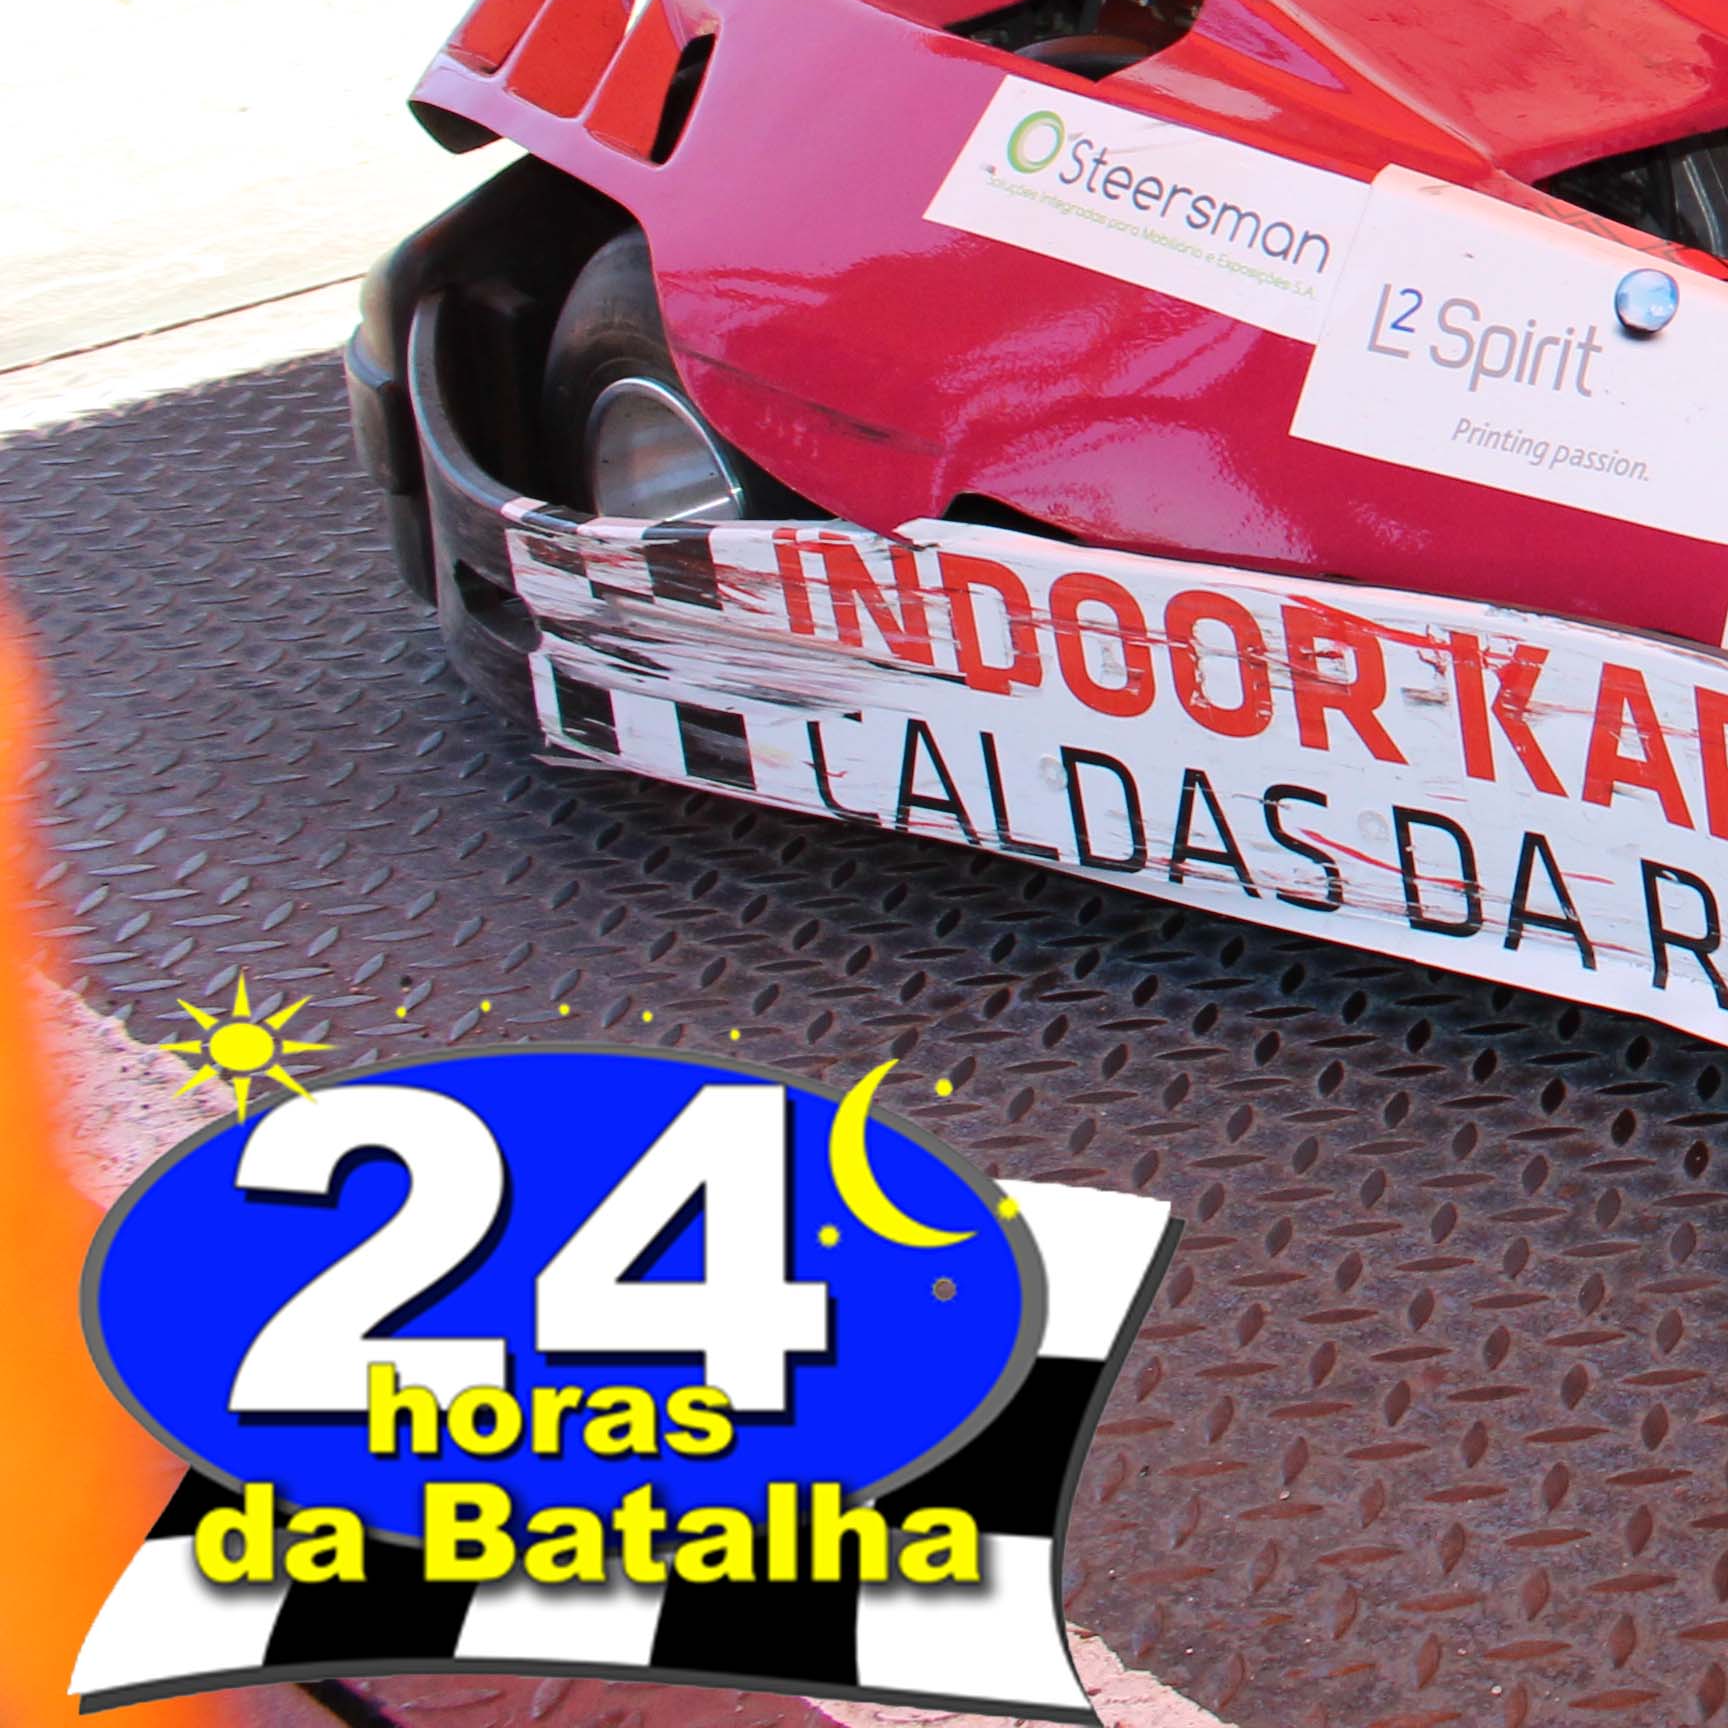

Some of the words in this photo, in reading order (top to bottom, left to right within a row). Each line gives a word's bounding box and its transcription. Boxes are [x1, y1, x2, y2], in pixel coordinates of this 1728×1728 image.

[1059, 138, 1331, 274] Steersman
[1428, 296, 1603, 398] Spirit
[1451, 417, 1550, 467] Printing
[1549, 443, 1650, 483] passion.
[773, 528, 1408, 764] INDOOR
[806, 711, 1345, 914] CALDAS
[1392, 804, 1597, 970] DA
